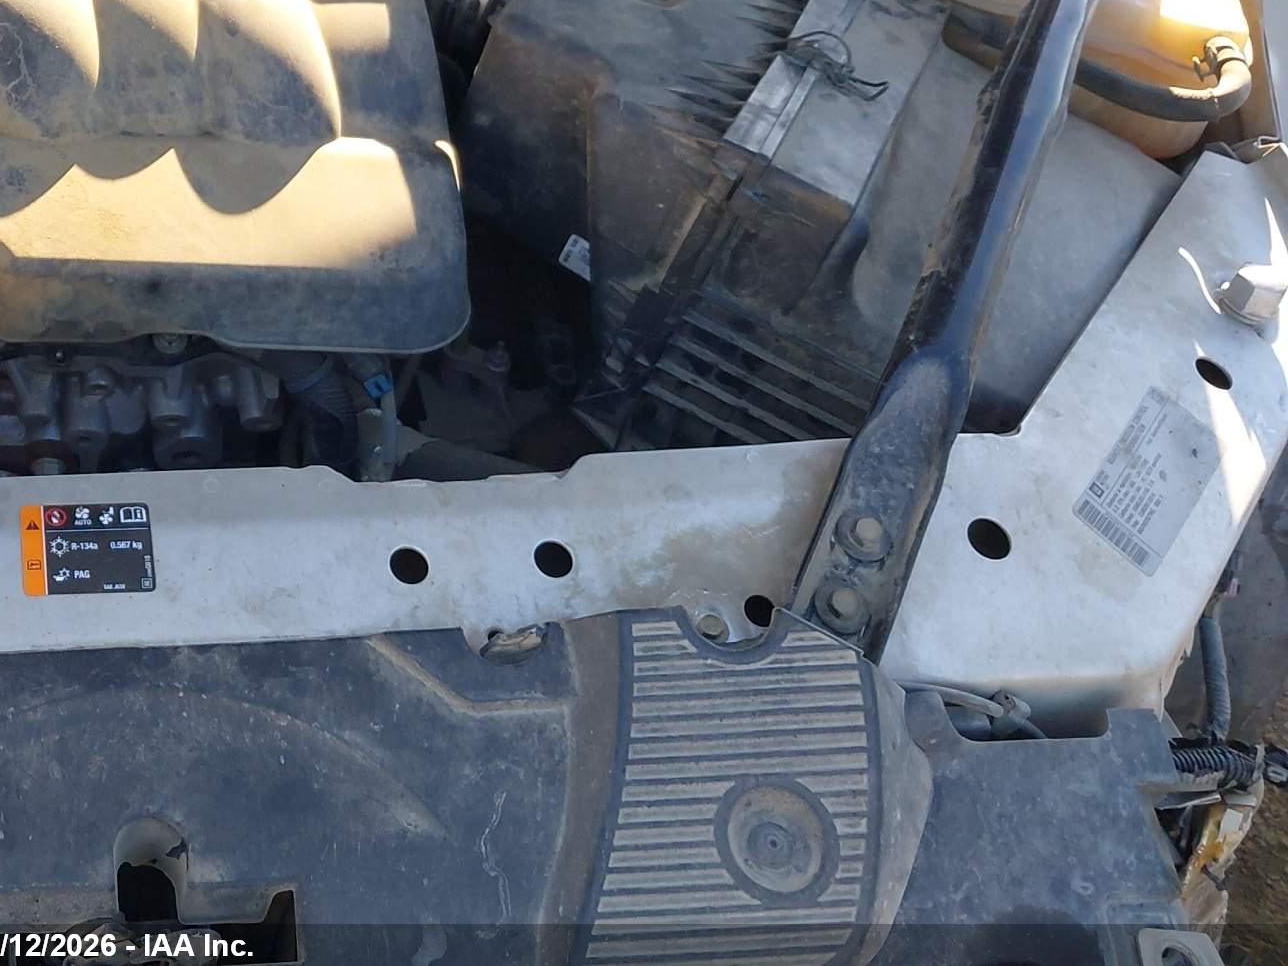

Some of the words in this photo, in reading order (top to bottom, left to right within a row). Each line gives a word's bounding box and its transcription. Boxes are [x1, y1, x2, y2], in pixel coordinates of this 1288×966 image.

[71, 541, 99, 551] R-134a
[132, 540, 143, 551] kg
[74, 570, 91, 579] PAG
